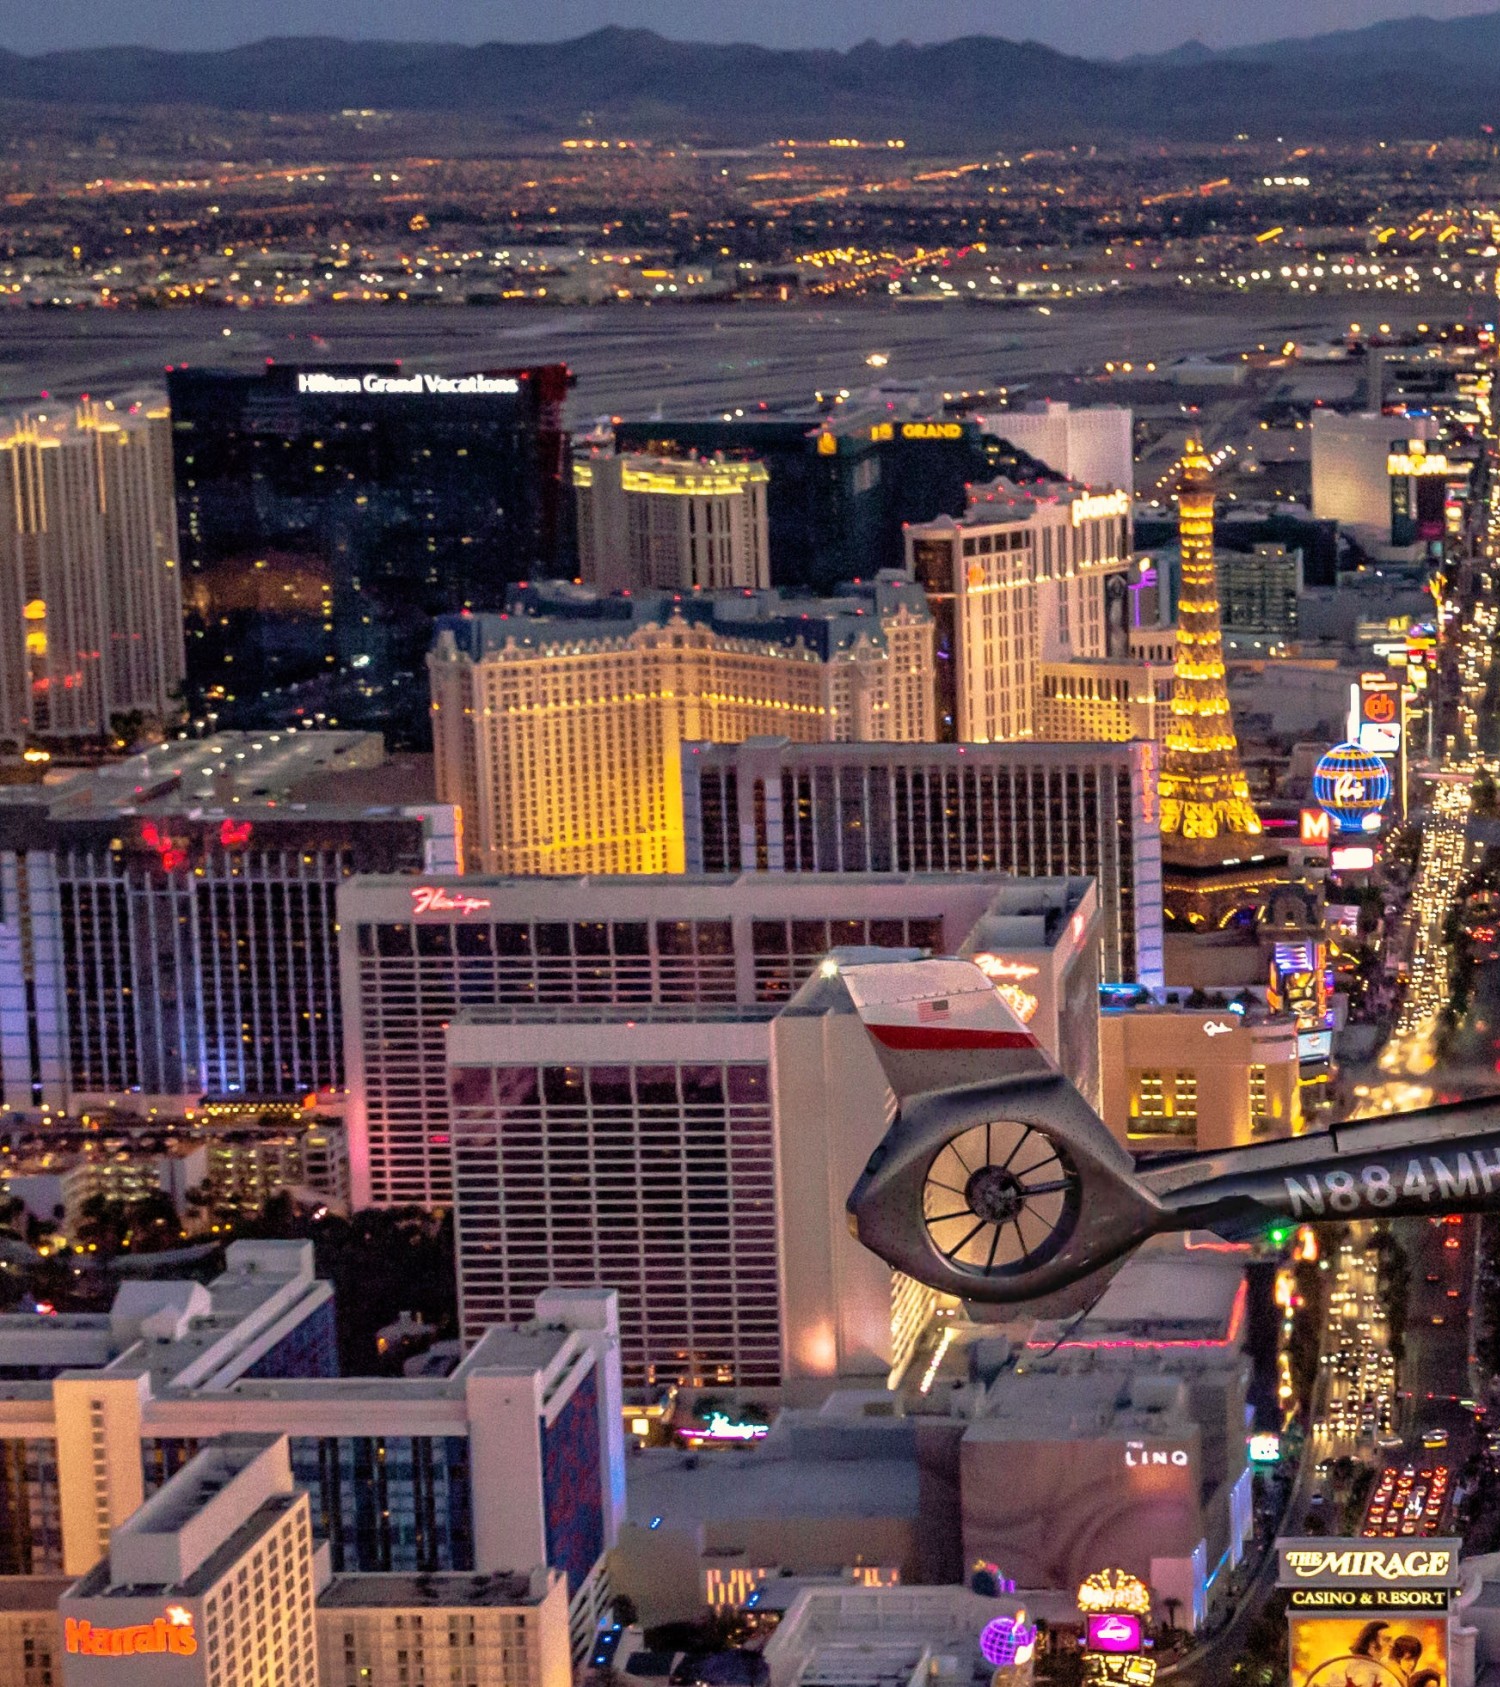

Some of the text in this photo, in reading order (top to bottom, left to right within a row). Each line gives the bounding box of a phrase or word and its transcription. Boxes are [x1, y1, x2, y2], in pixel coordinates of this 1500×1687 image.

[298, 374, 519, 393] Hilton Grand Vacations
[902, 422, 963, 439] GRAND
[1072, 489, 1129, 528] planet
[411, 887, 491, 915] Flamingo
[1125, 1451, 1188, 1466] LINQ
[1286, 1551, 1450, 1580] THE MIRAGE
[1292, 1591, 1445, 1605] CASINO & RESORT
